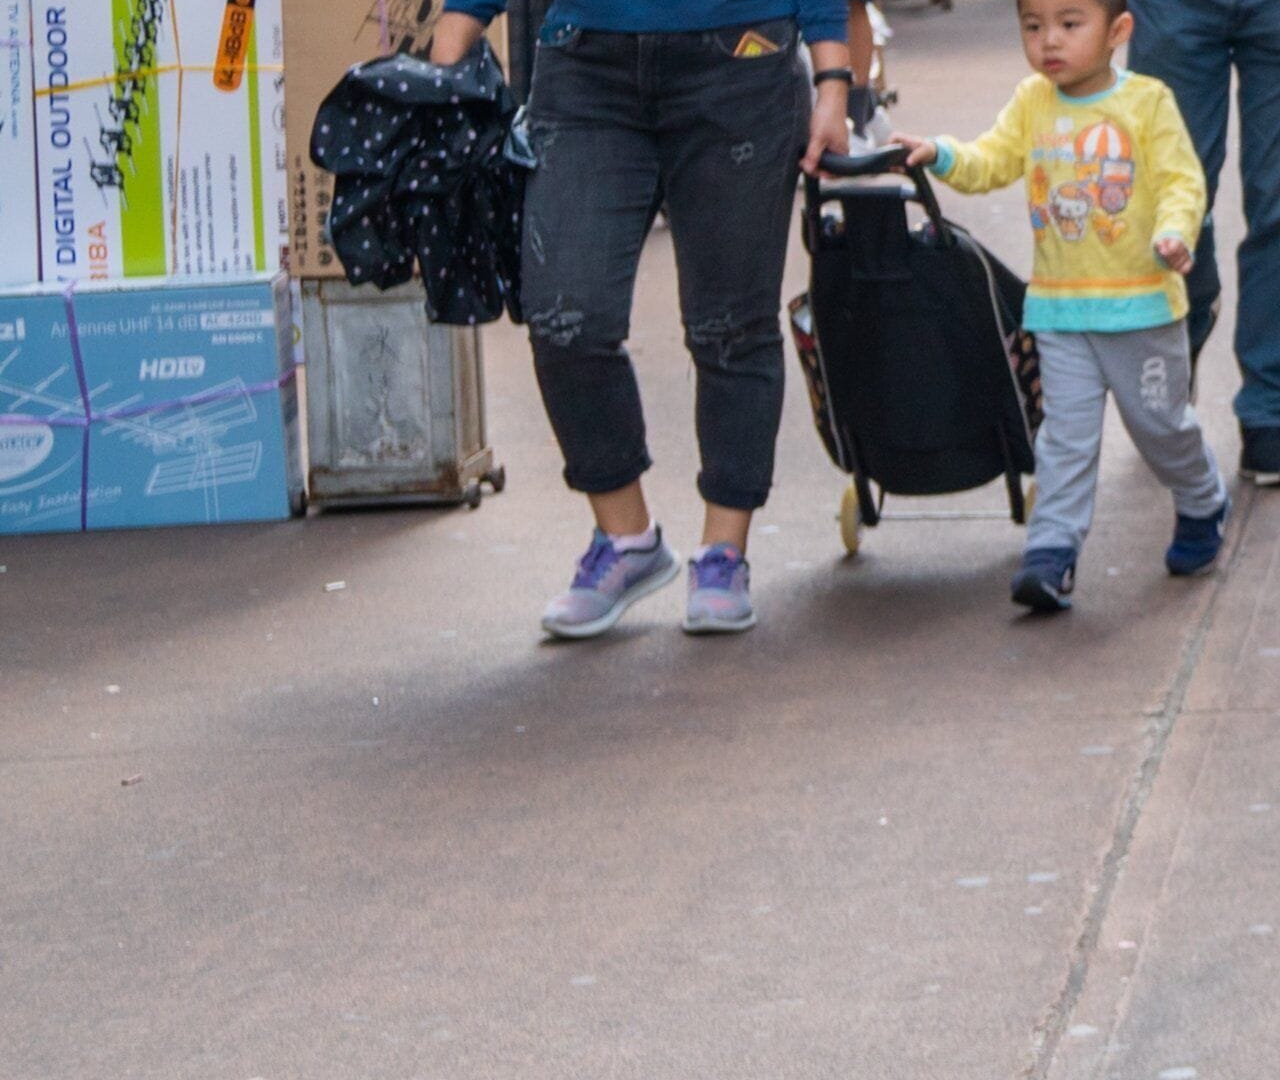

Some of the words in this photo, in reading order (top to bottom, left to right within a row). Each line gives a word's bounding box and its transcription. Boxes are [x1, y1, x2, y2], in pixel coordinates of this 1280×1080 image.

[6, 28, 21, 106] ATENNA
[45, 7, 70, 148] OUTDOOR
[53, 159, 77, 266] DIGITAL
[51, 320, 117, 340] Anenne
[119, 315, 151, 336] UHF
